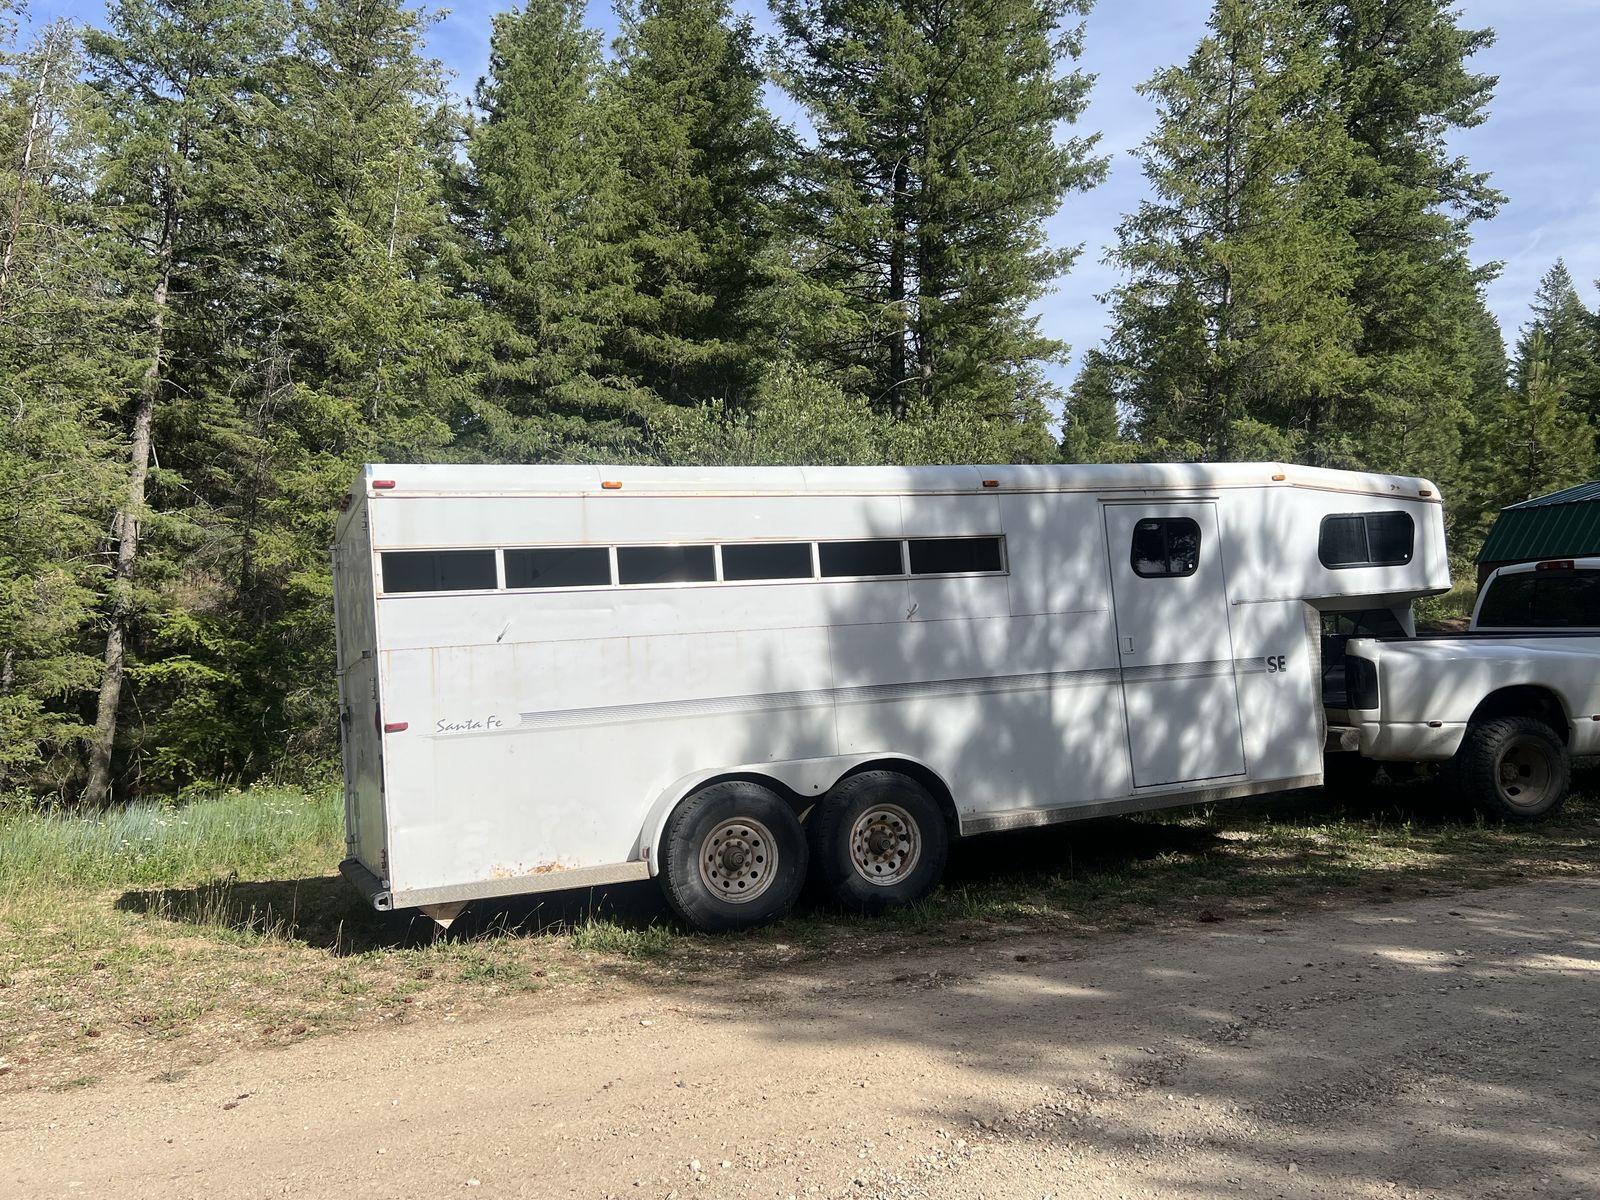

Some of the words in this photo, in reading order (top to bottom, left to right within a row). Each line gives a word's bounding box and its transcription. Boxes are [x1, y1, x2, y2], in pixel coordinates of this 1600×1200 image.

[1267, 655, 1287, 673] SE
[436, 718, 483, 733] Santa
[486, 715, 504, 729] Fe
